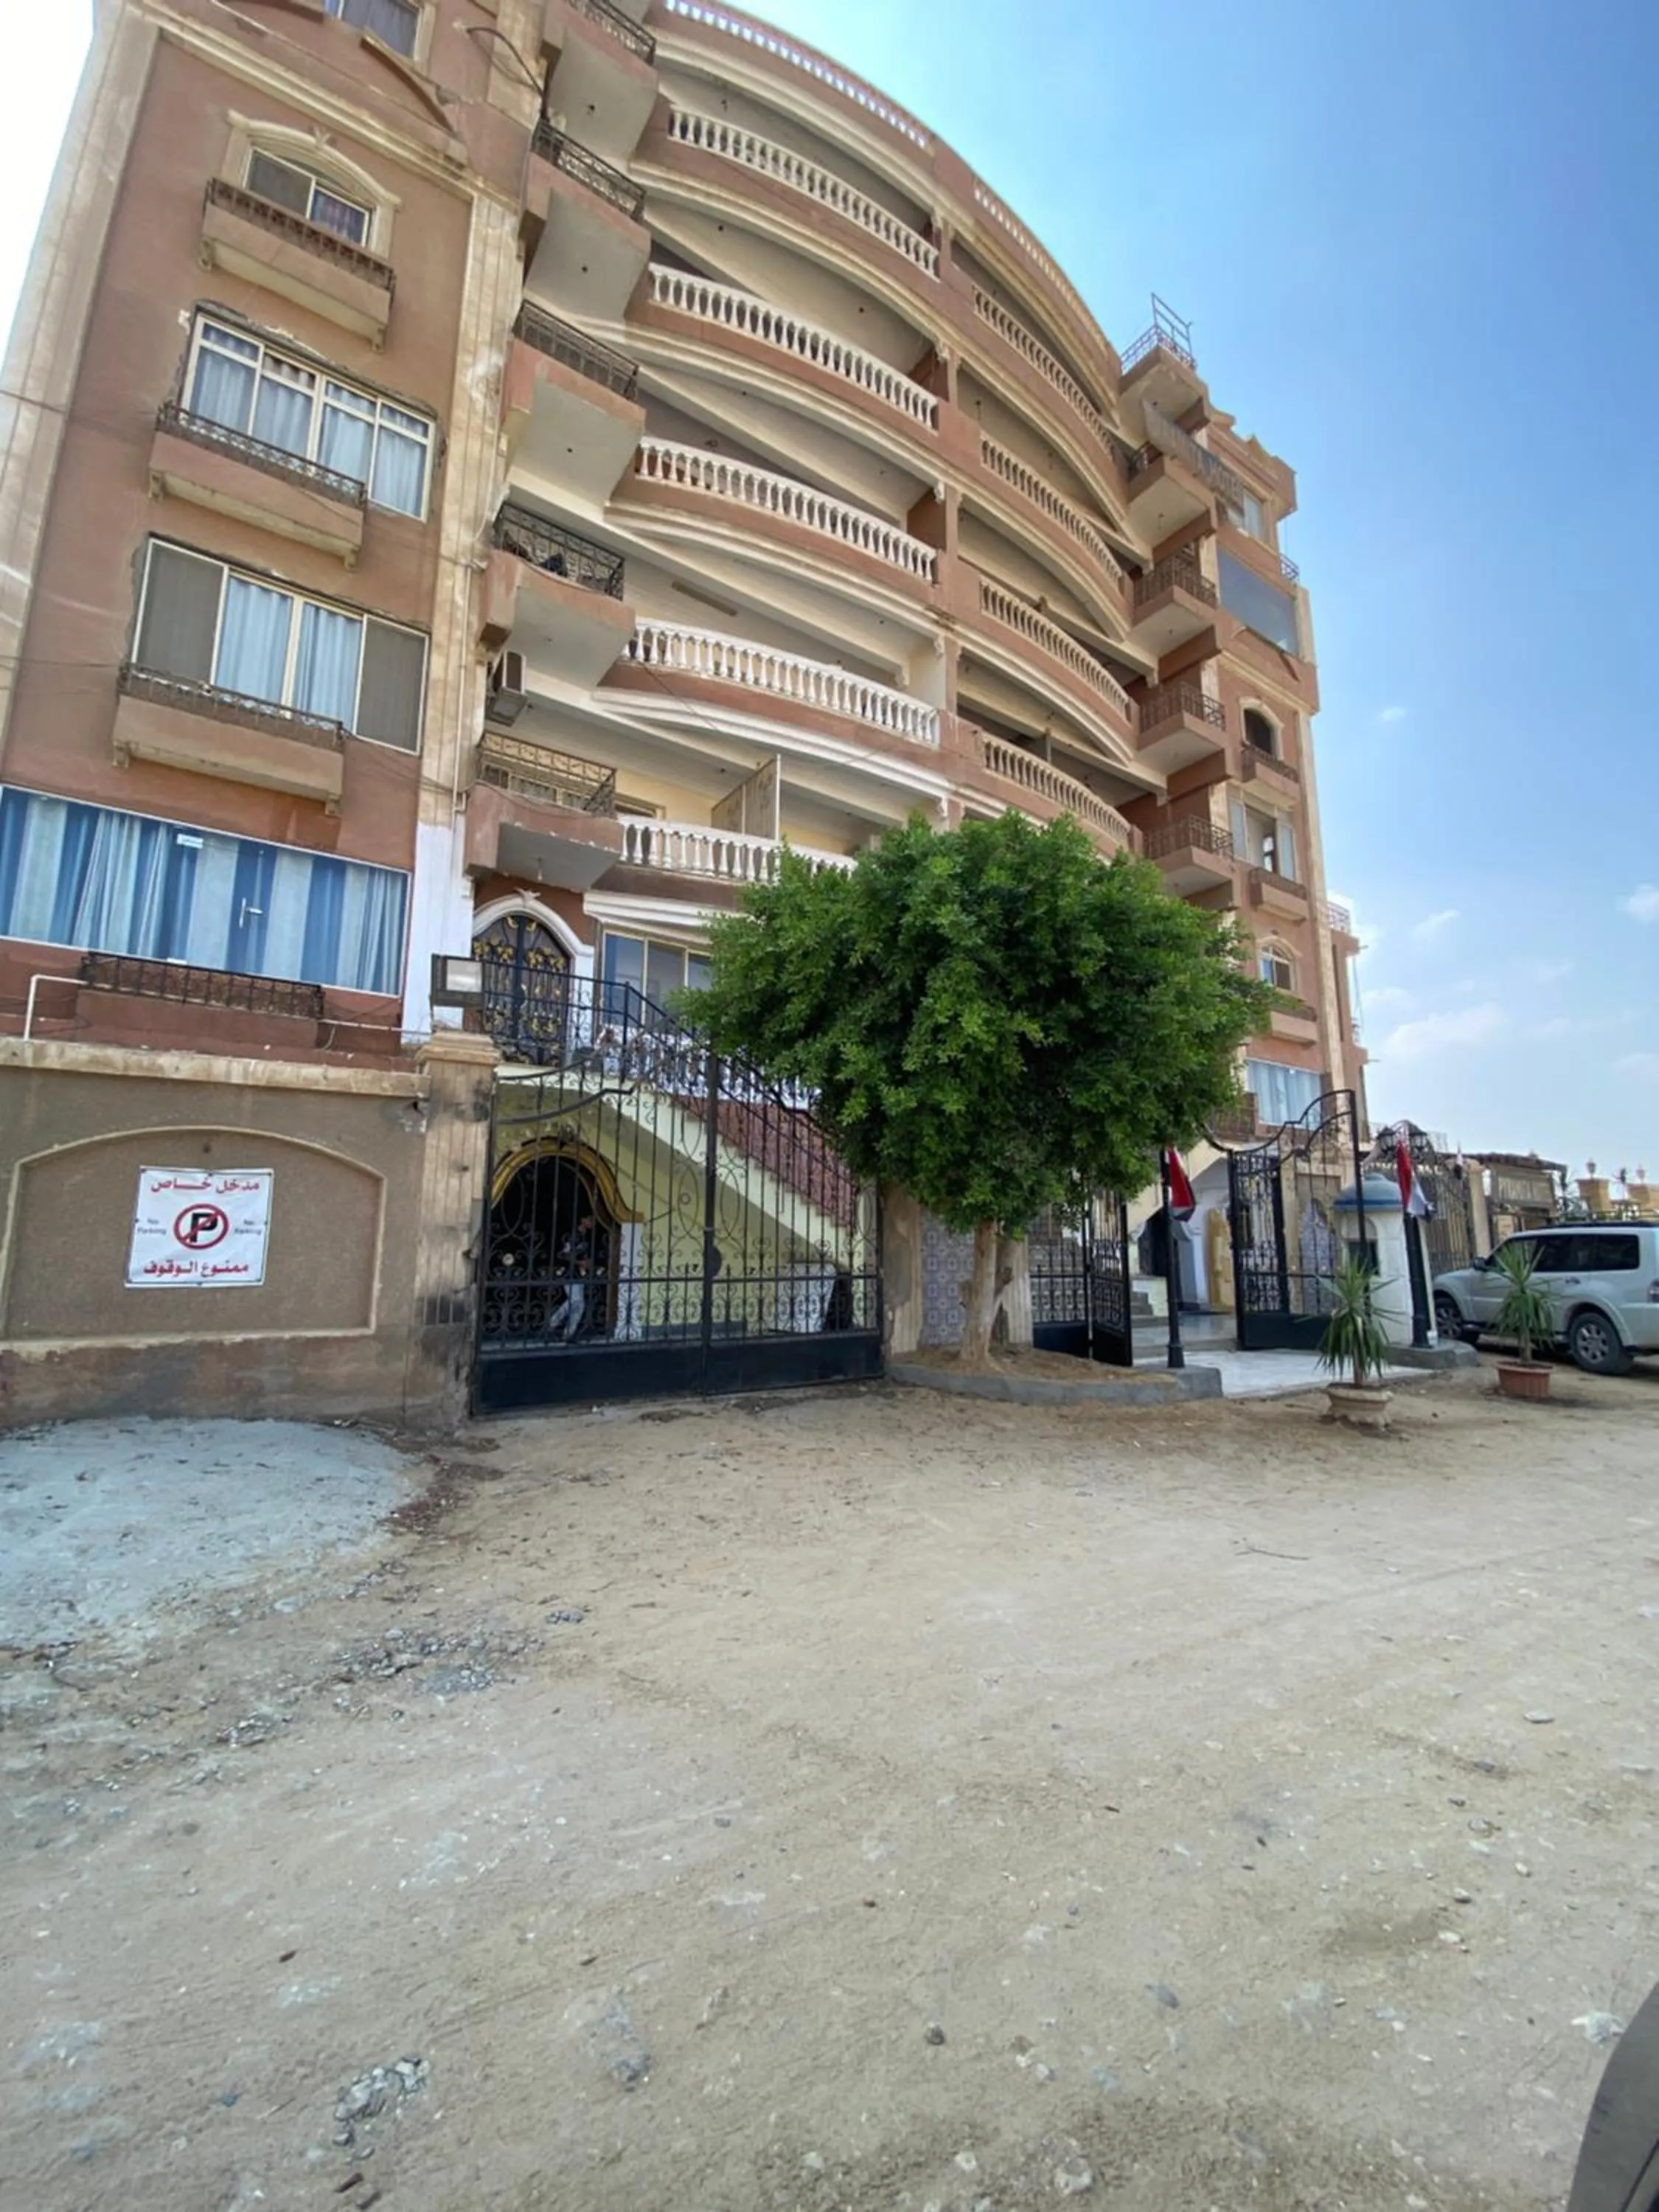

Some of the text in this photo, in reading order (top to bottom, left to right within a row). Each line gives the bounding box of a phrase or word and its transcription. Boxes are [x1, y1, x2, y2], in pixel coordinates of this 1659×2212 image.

[150, 1177, 260, 1194] مدخل خاص
[143, 1259, 249, 1278] ممنوع الوقوف
